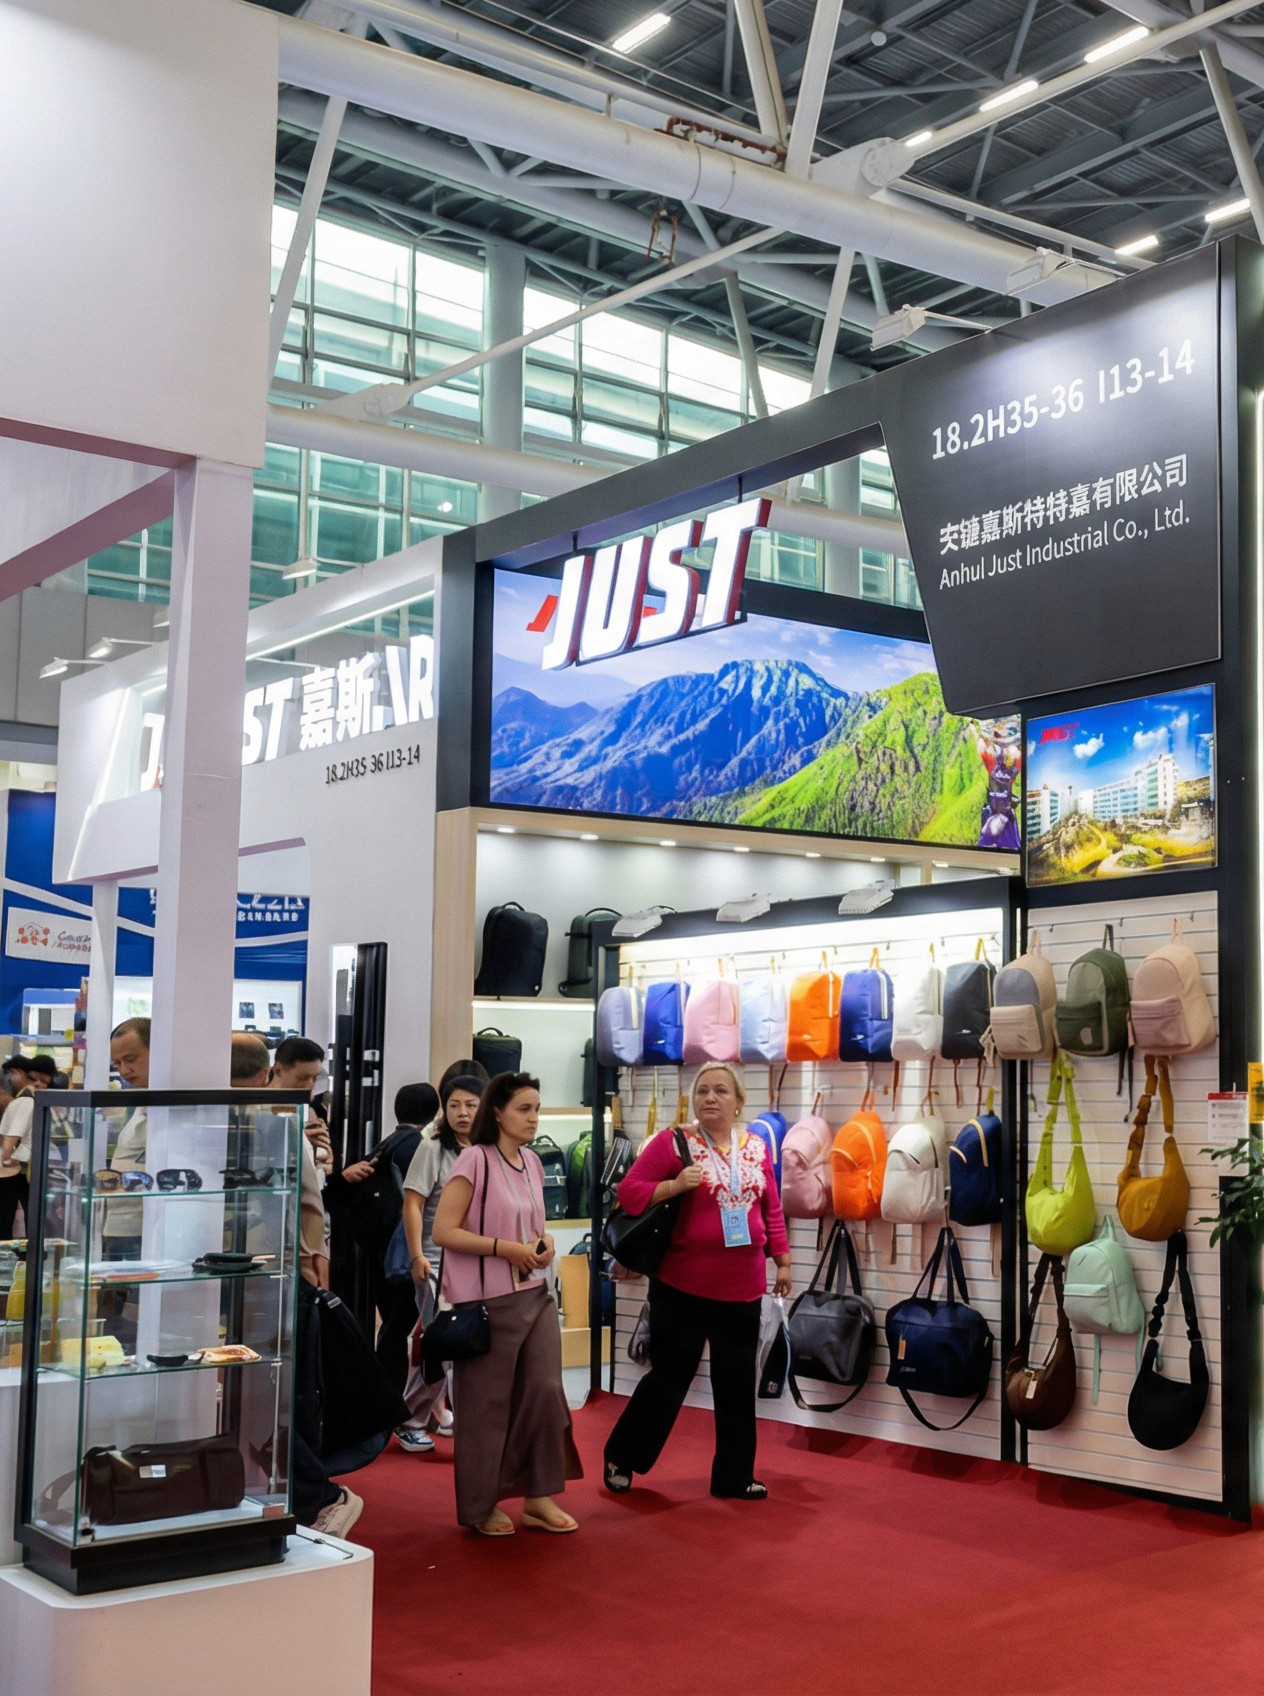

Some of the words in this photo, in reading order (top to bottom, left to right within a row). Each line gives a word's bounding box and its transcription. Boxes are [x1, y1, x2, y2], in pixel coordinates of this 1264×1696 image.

[932, 379, 1084, 460] 18.2H35-36
[1098, 338, 1195, 404] I13-14
[542, 497, 772, 670] JUST
[988, 548, 1022, 577] Just
[1026, 521, 1108, 567] Industrial
[1113, 518, 1148, 543] Co.,
[1154, 500, 1190, 531] Ltd.
[140, 677, 294, 792] JST
